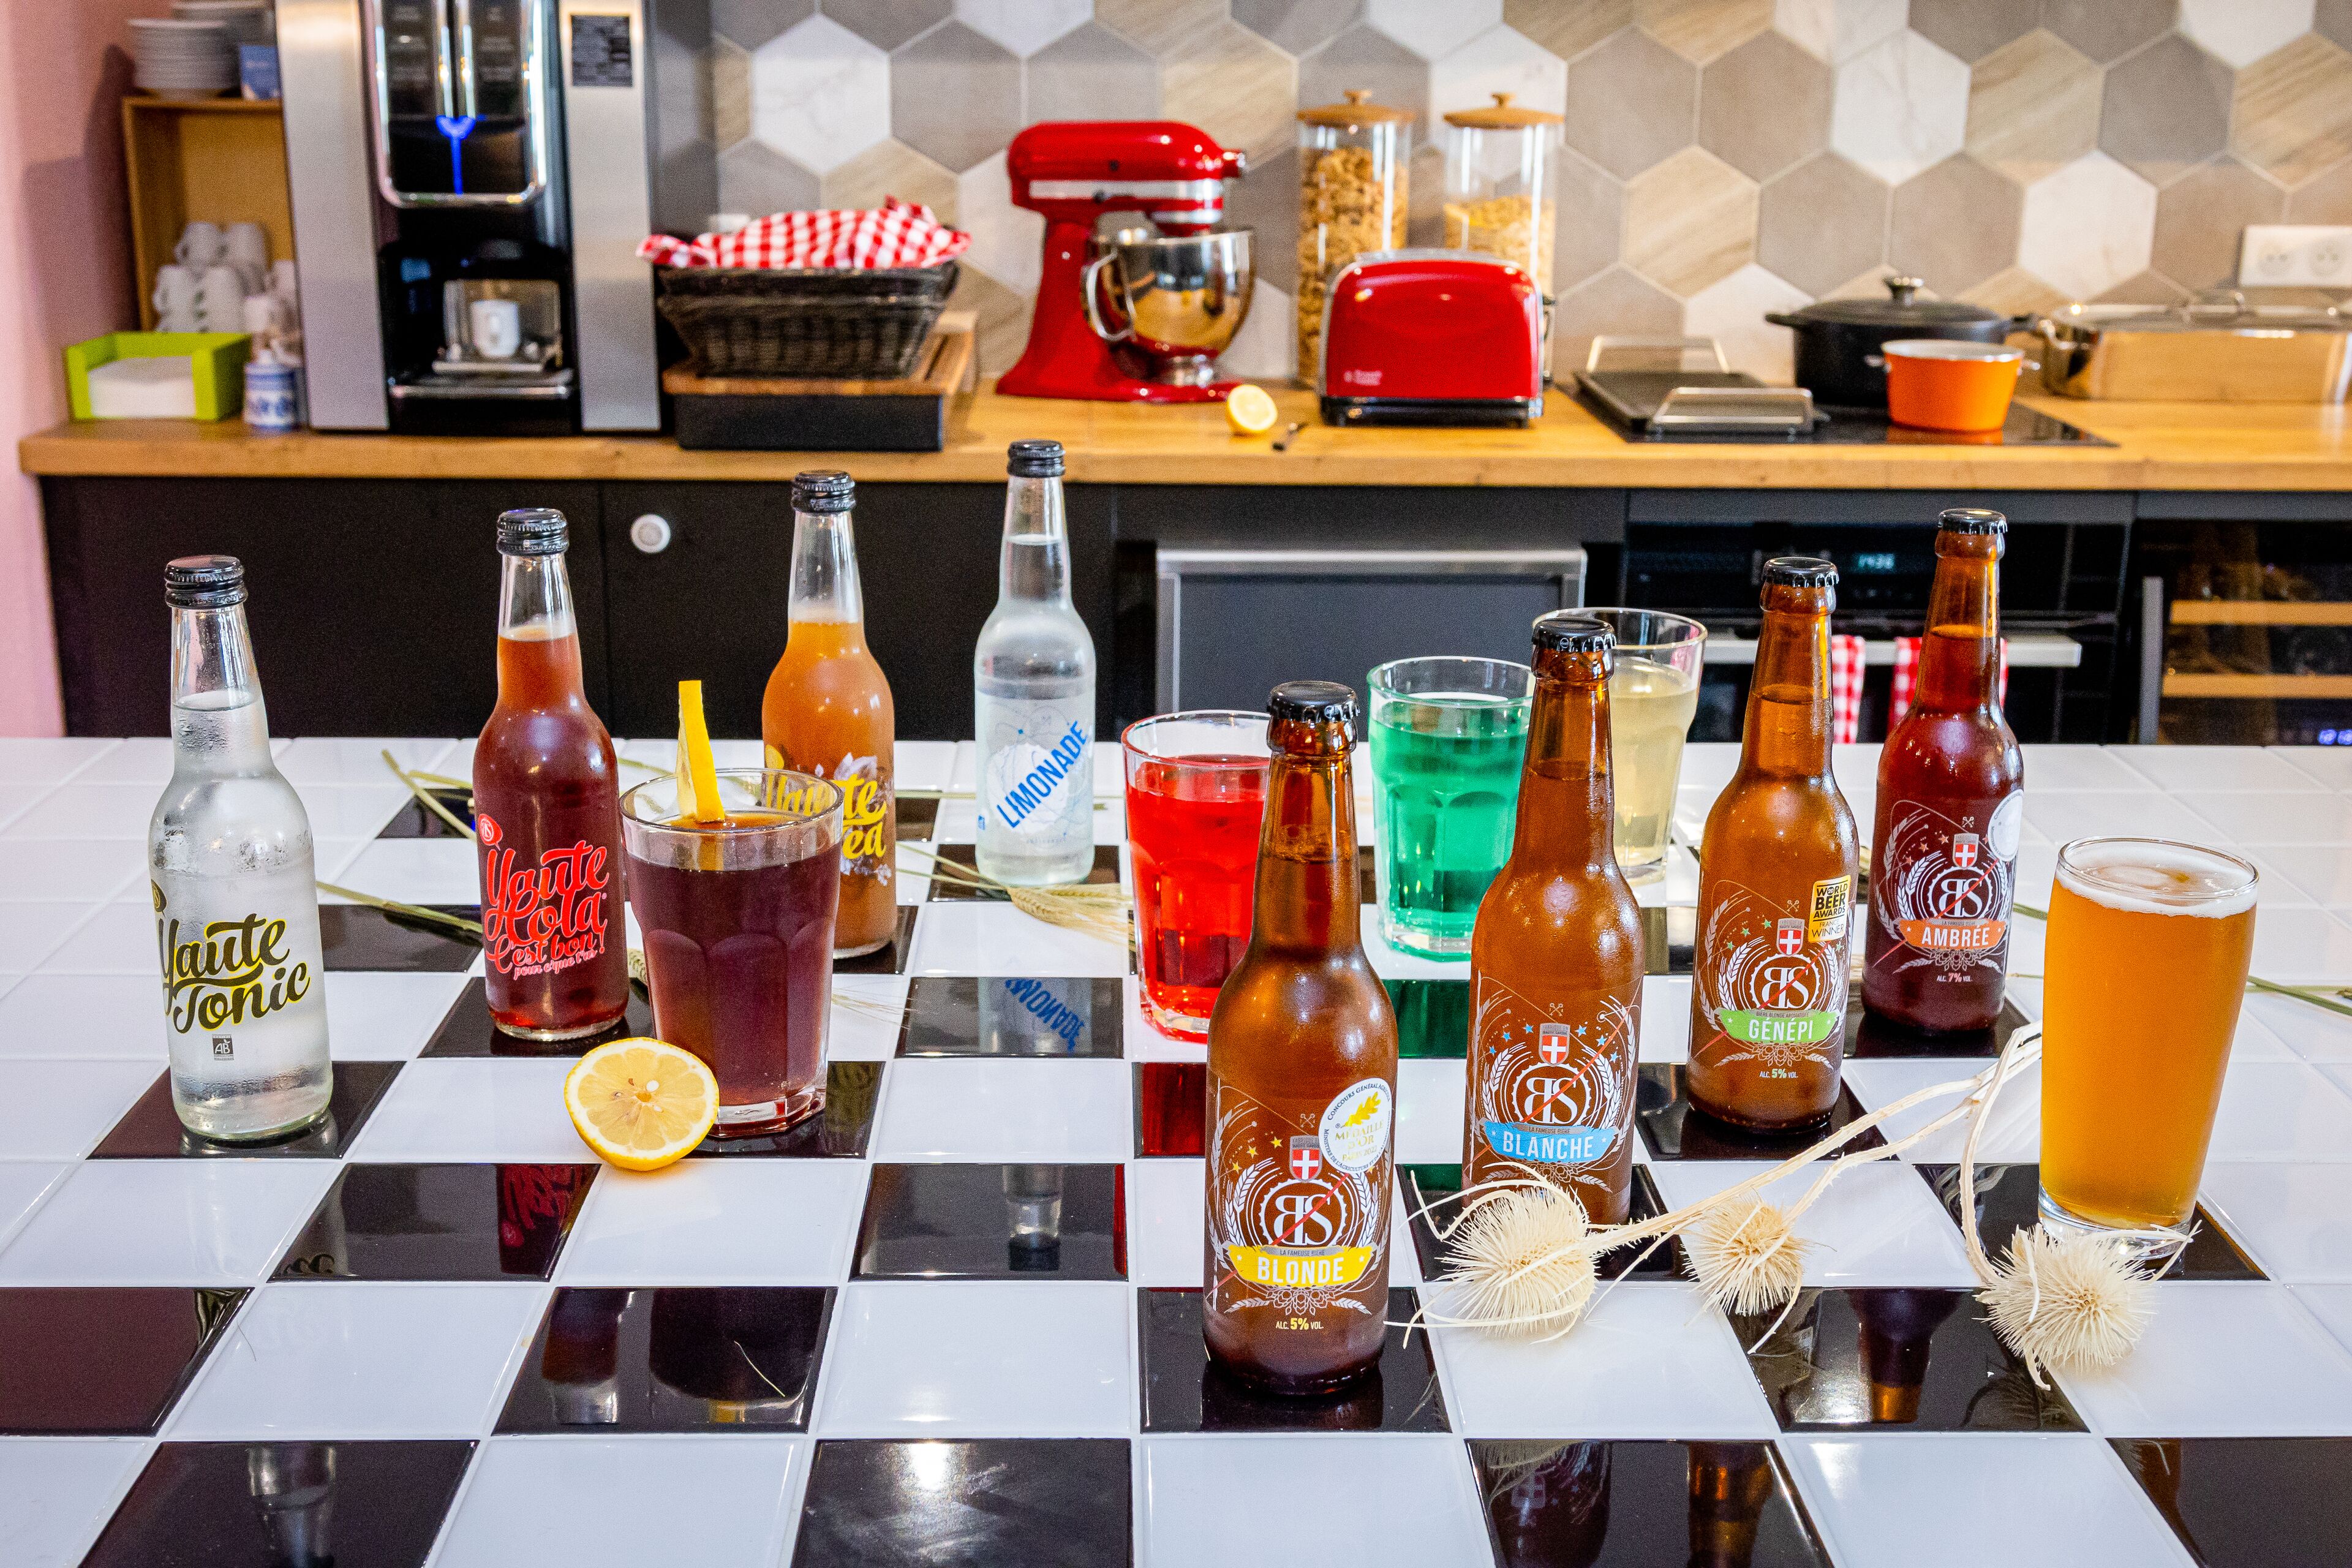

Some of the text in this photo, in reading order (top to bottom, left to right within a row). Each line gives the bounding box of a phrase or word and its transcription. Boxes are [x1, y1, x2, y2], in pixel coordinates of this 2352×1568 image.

[997, 720, 1087, 828] LIMONADE
[1815, 892, 1845, 911] BEER
[1813, 905, 1845, 919] AWARDS
[1812, 924, 1844, 938] WINNER
[1921, 925, 1990, 947] AMBRÉE
[1948, 972, 1962, 982] 7%
[1749, 1017, 1813, 1041] GÉNÉPI
[1771, 1068, 1787, 1078] 5%
[1327, 1091, 1355, 1120] CONCOURS
[1503, 1131, 1594, 1160] BLANCHE
[1257, 1256, 1344, 1283] BLONDE
[1276, 1317, 1324, 1330] ALC. 5% VOL.
